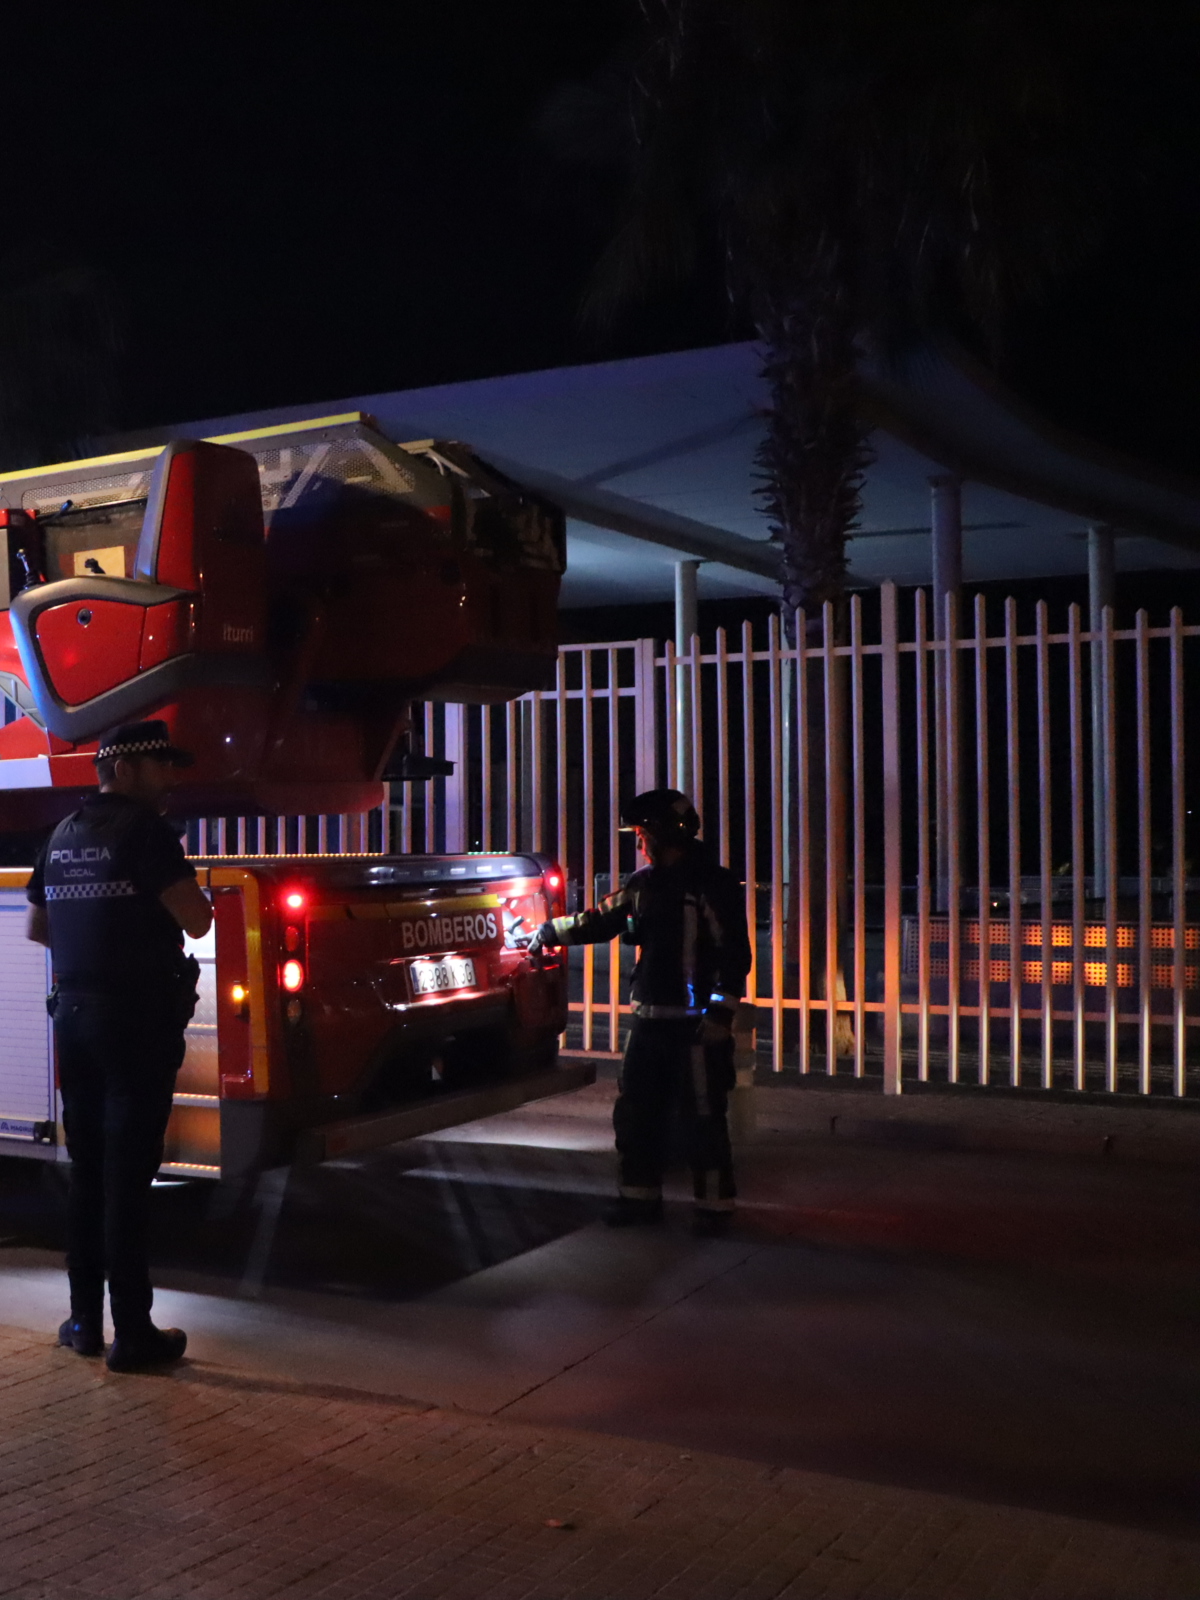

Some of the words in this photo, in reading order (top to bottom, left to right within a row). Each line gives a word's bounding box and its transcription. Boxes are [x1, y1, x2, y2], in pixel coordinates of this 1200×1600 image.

[50, 847, 111, 864] POLICIA
[64, 868, 96, 877] LOCAL
[402, 913, 497, 948] BOMBEROS
